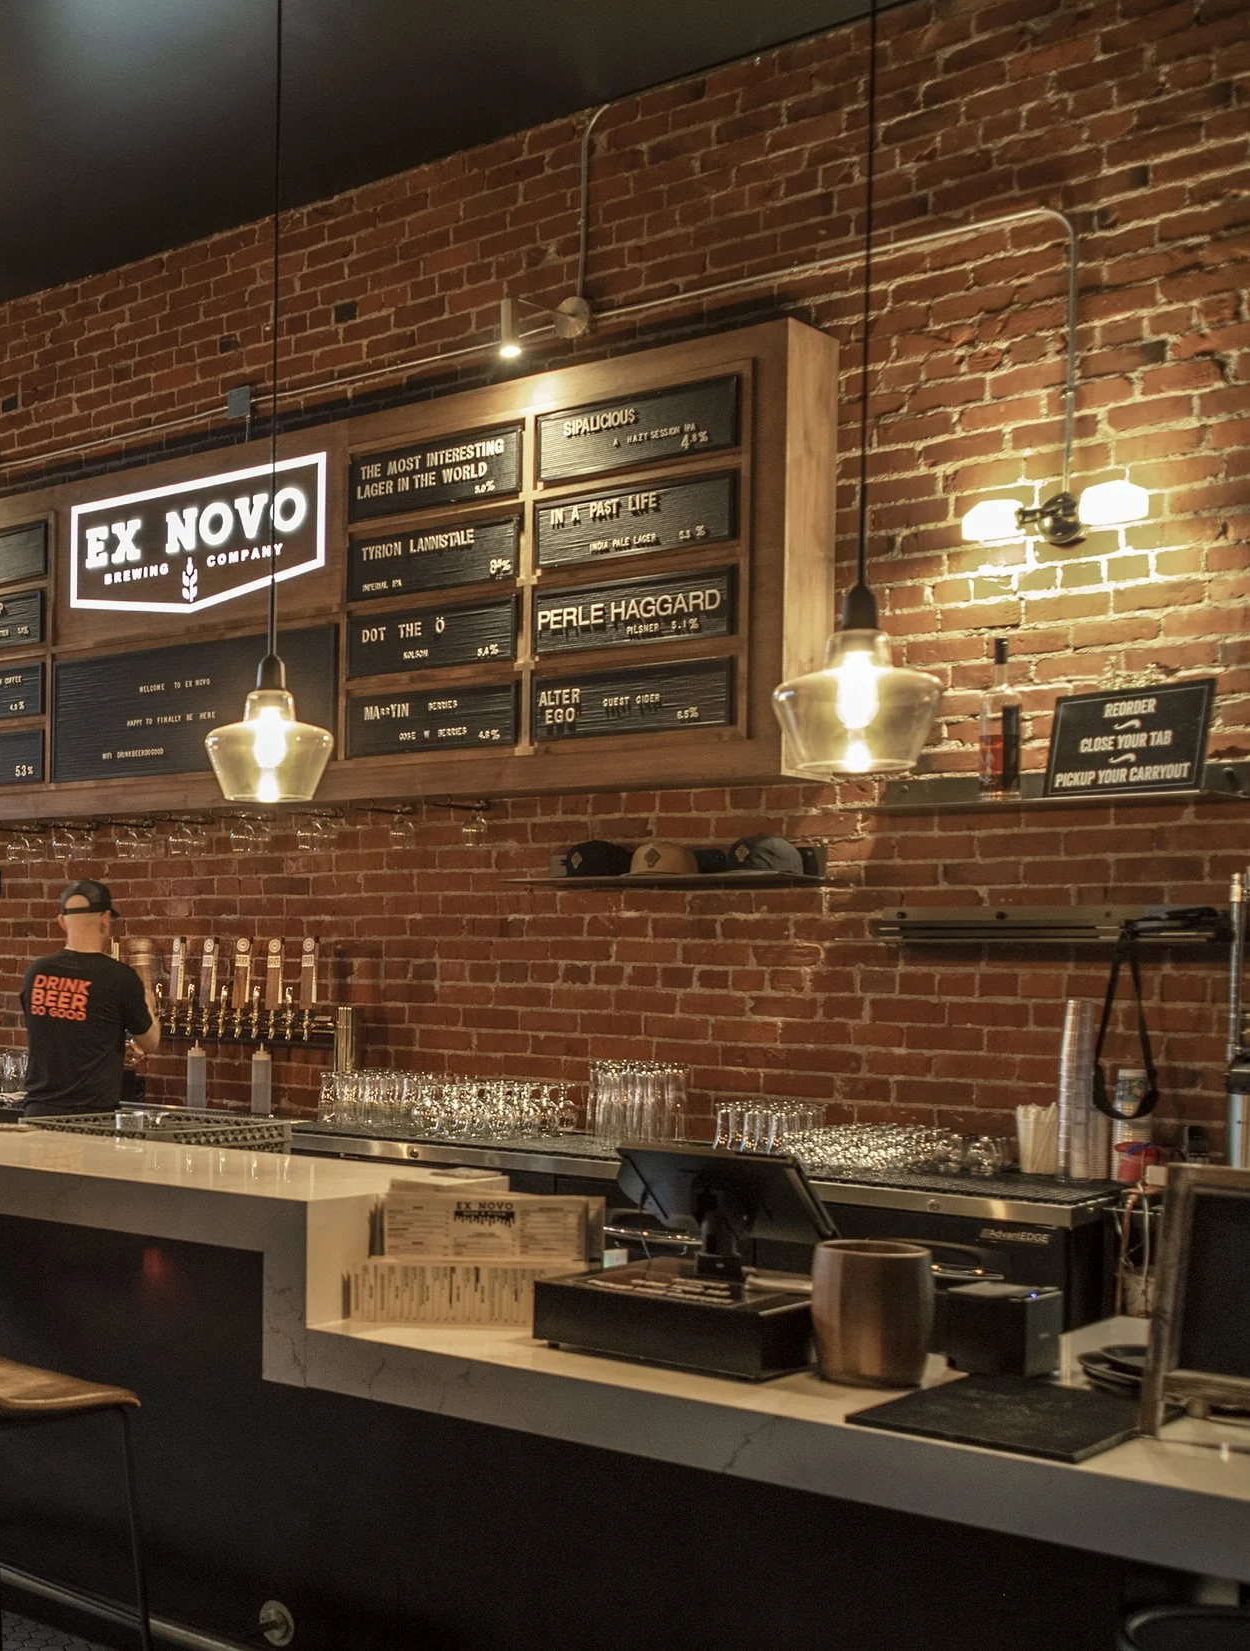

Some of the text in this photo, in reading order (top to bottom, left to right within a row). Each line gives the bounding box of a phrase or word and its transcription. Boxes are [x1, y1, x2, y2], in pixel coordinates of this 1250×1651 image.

[613, 423, 696, 448] A HAZY SESSION IPA
[360, 438, 504, 480] THE MOST INTERESTING
[357, 462, 488, 500] LAGER IN THE WORLD
[550, 492, 659, 525] IN A PAST LIFE
[85, 487, 307, 569] EX NOVO
[361, 529, 475, 561] TYRION LANNISTALE
[589, 532, 656, 553] INDIA PALE LAGER
[104, 542, 283, 585] BREWING COMPANY
[392, 579, 402, 588] IPA
[537, 589, 721, 631] PERLE HAGGARD
[361, 616, 445, 643] DOT THE Ö
[626, 622, 659, 635] PILSNER
[4, 675, 22, 684] COFFEE
[139, 678, 211, 693] WELCOME TO EX NOVO
[428, 700, 458, 711] BERRIES
[538, 688, 581, 707] ALTER
[603, 693, 661, 707] GUEST CIDER
[545, 707, 576, 725] EGO
[1103, 698, 1158, 719] REORDER
[126, 719, 143, 728] HAPPY
[145, 717, 152, 725] TO
[157, 715, 181, 724] FINALLY
[199, 711, 216, 720] HERE
[437, 727, 467, 738] BERRIES
[1079, 729, 1173, 753] CLOSE YOUR TAB
[1054, 762, 1192, 788] PICKUP YOUR CARRYOUT
[33, 974, 92, 995] DRINK
[31, 988, 88, 1012] BEER
[31, 1005, 87, 1021] DO GOOD
[456, 1201, 514, 1210] EX NOVO
